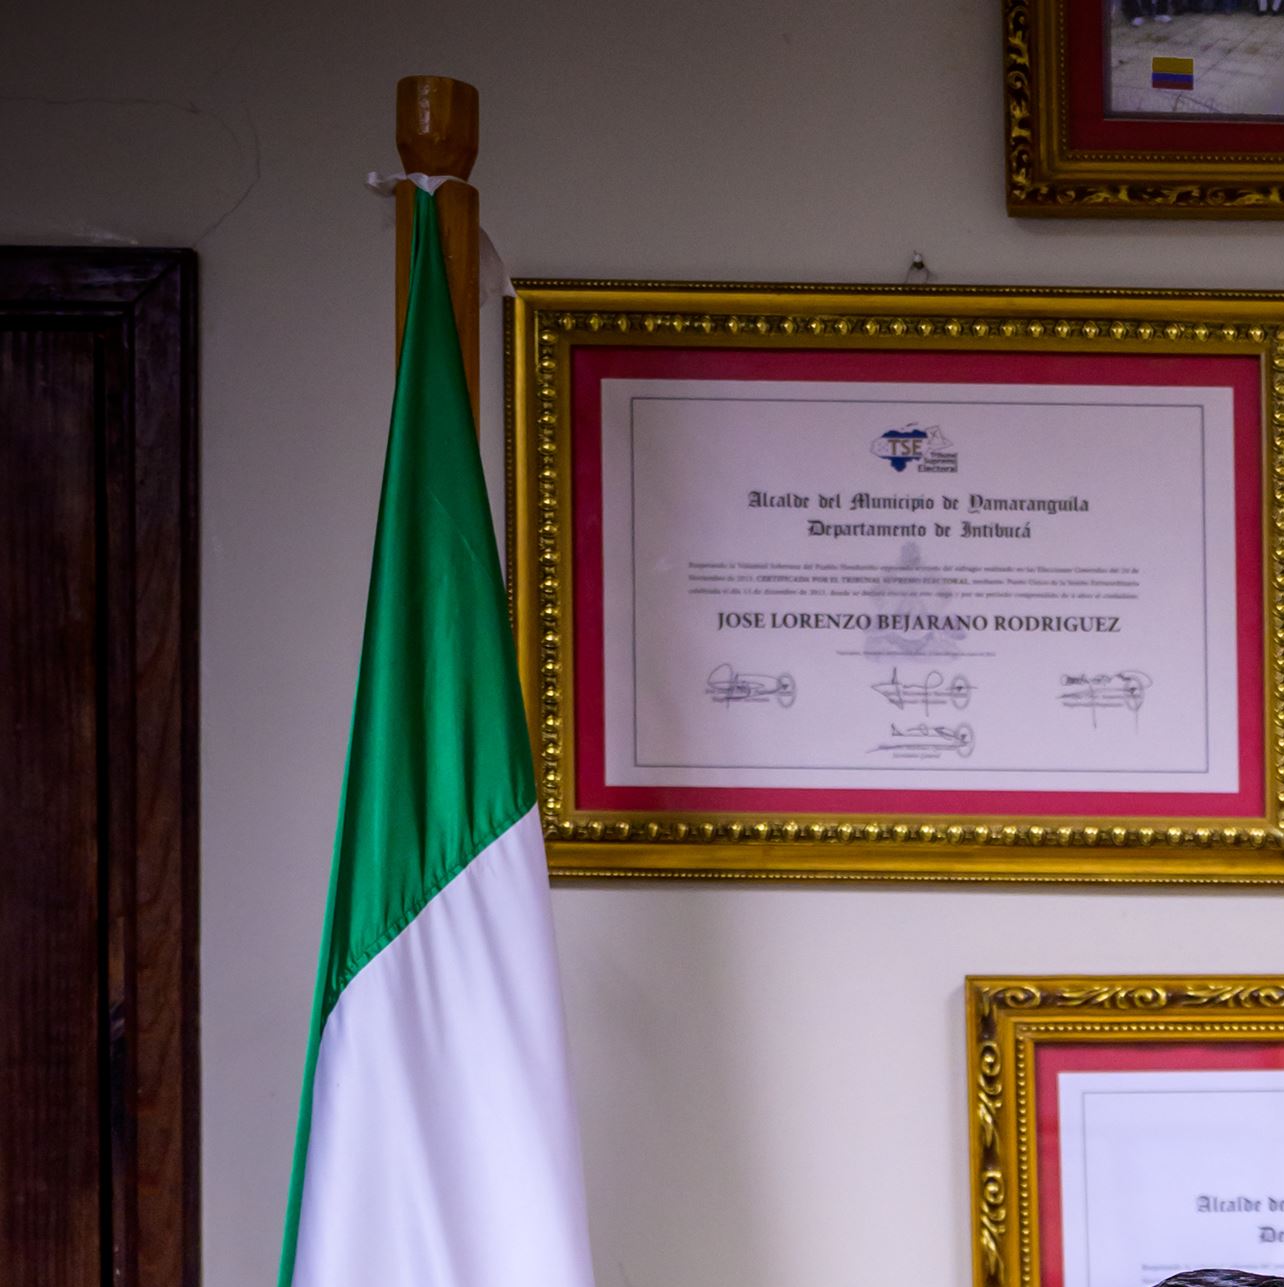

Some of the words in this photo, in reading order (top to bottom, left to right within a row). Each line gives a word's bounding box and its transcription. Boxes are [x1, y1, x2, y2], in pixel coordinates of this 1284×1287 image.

[888, 439, 922, 456] TSE
[918, 465, 958, 473] Electoral
[747, 491, 810, 510] Alcalde
[819, 493, 841, 509] del
[851, 492, 935, 513] Municipio
[942, 495, 959, 510] de
[968, 493, 1089, 515] Yamaranguila
[807, 519, 927, 539] Departamento
[935, 522, 951, 538] de
[960, 519, 1031, 538] Intibucá
[717, 612, 765, 630] JOSE
[771, 612, 872, 630] LORENZO
[877, 614, 988, 632] BEJARANO
[994, 615, 1121, 633] RODRIGUEZ
[1196, 1195, 1261, 1213] Alcalde
